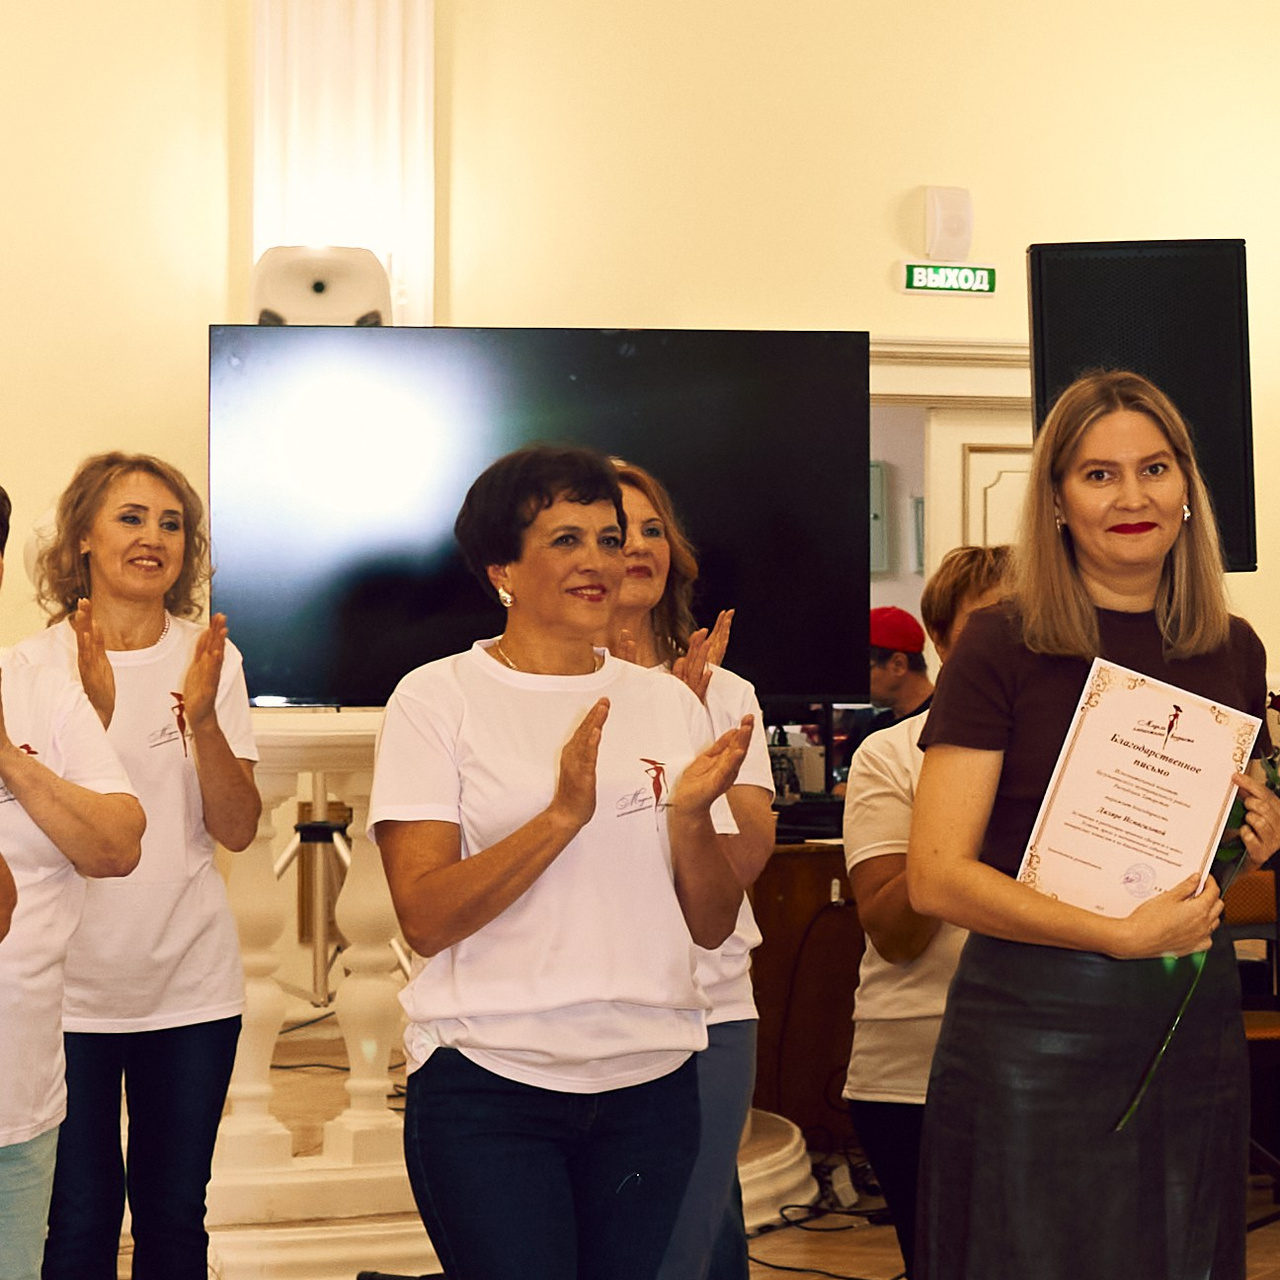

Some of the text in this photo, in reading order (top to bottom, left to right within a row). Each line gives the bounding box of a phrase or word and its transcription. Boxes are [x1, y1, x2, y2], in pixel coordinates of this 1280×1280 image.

[913, 267, 989, 291] ВЫХОД
[1110, 733, 1202, 774] Благодарственное
[1133, 759, 1171, 777] письмо
